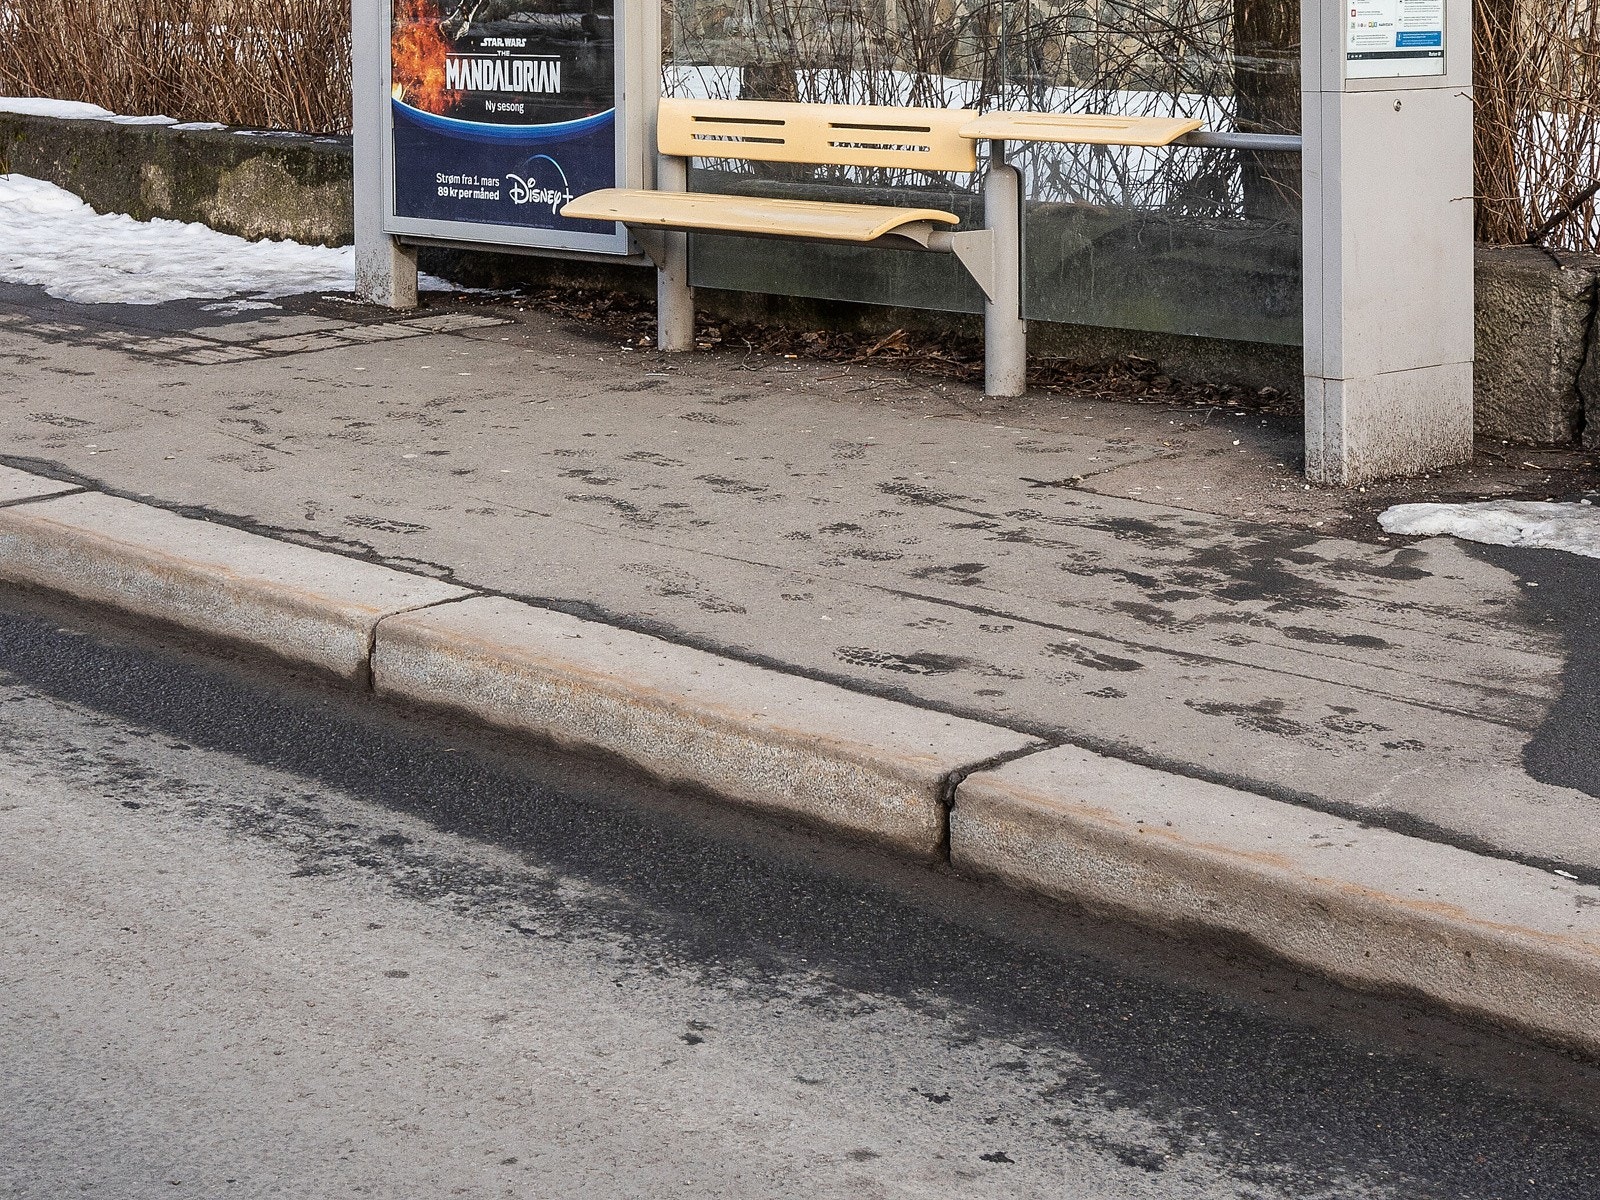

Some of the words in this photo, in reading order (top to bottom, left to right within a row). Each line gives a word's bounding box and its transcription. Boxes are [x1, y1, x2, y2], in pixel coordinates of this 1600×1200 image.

[480, 38, 504, 47] STAR
[504, 38, 527, 47] WARS
[445, 58, 561, 94] MANDALORIAN
[485, 100, 496, 113] Ny
[497, 102, 524, 114] sesong
[436, 172, 461, 185] Strøm
[461, 174, 473, 185] fra
[473, 175, 480, 186] 1.
[480, 177, 500, 187] mars
[437, 186, 449, 197] 89
[449, 187, 458, 198] kr
[458, 188, 473, 200] per
[473, 187, 500, 200] måned
